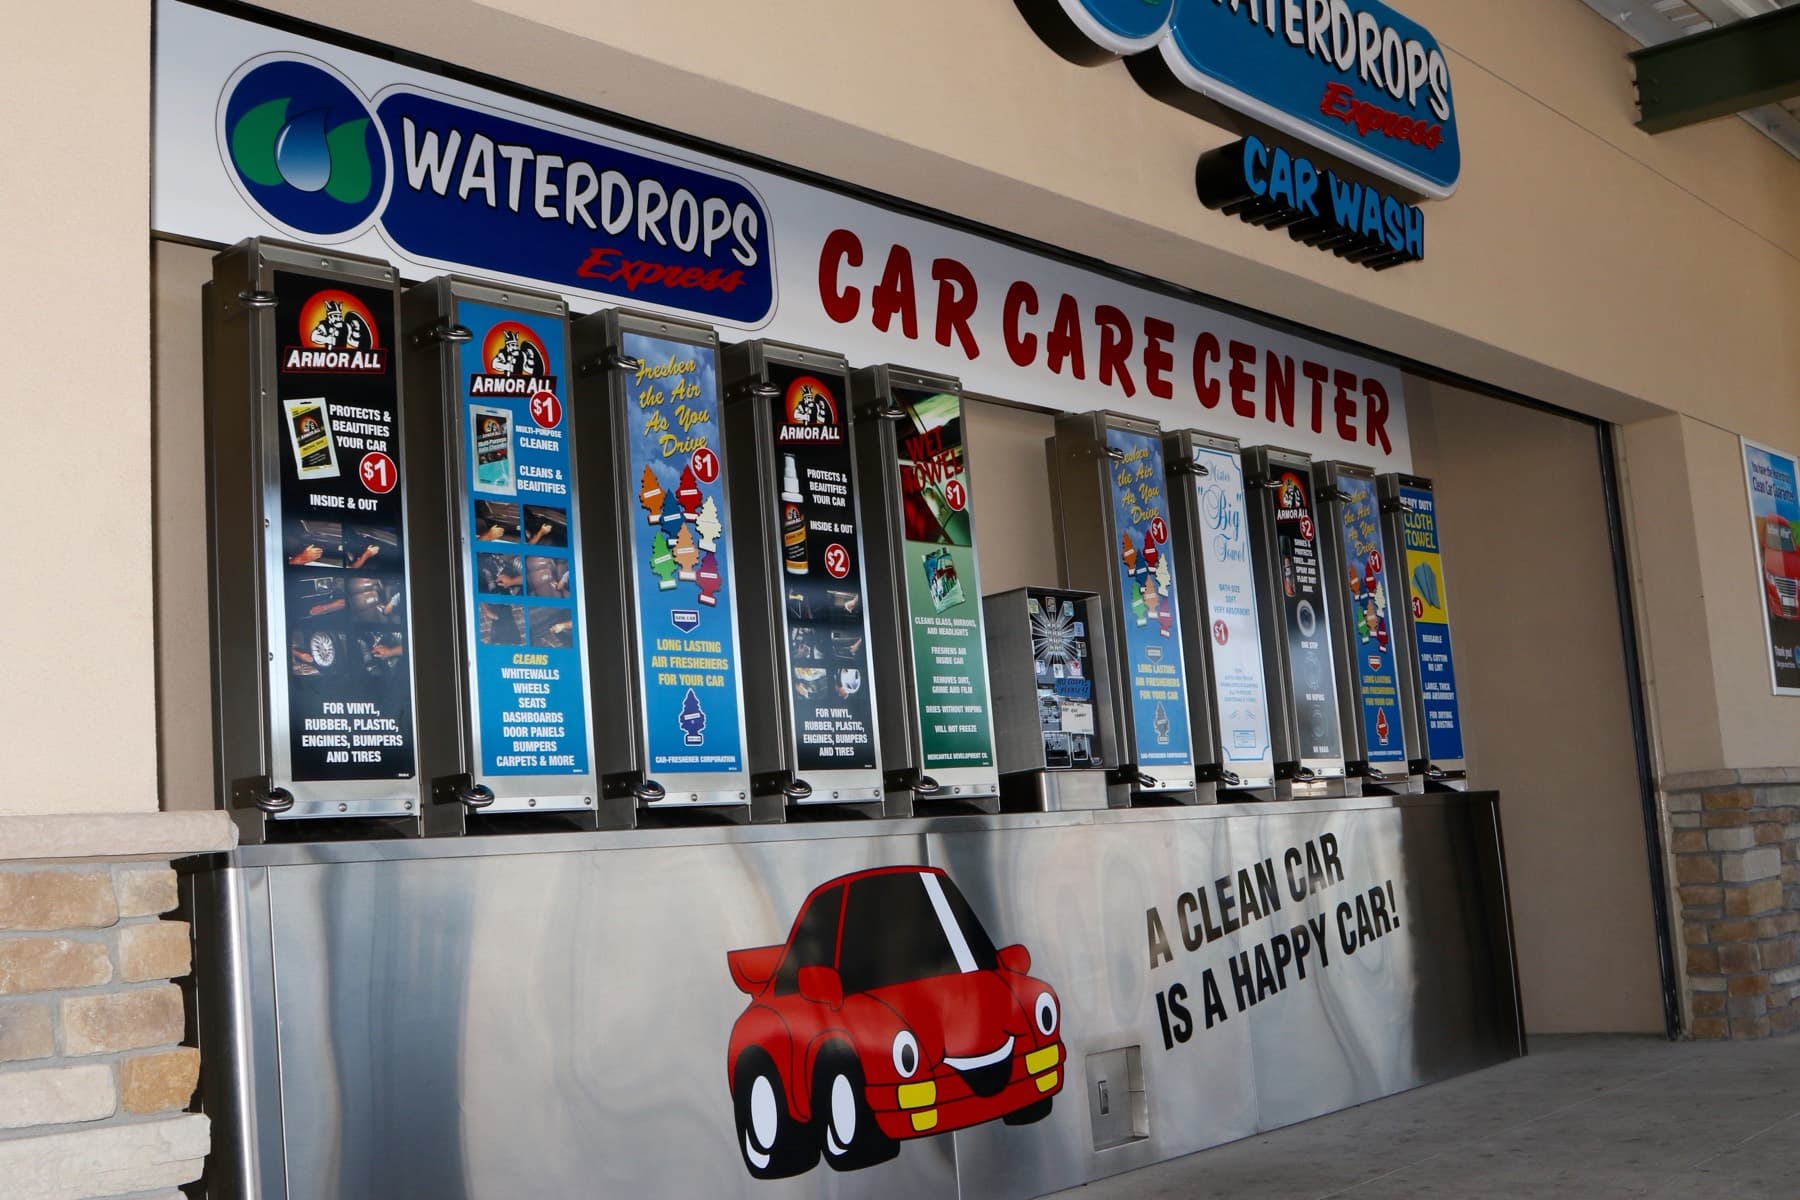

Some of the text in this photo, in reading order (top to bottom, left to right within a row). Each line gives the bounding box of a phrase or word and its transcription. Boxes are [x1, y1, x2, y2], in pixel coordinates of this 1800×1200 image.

[1320, 82, 1444, 150] Express
[402, 115, 758, 266] WATERDROPS
[1243, 135, 1425, 259] CAR WASH
[576, 248, 746, 293] Express
[818, 229, 1392, 456] CAR CARE CENTER
[287, 349, 381, 369] ARMOR ALL
[635, 354, 696, 386] Freshen
[472, 376, 552, 393] ARMOR ALL
[640, 379, 701, 408] the Air
[329, 404, 380, 421] PROTECTS
[383, 411, 391, 422] &
[533, 397, 553, 422] $1
[644, 404, 709, 436] As You
[332, 420, 389, 437] BEAUTIFIES
[780, 425, 840, 440] ARMOR ALL
[336, 435, 364, 449] YOUR
[366, 439, 387, 452] CAR
[520, 436, 559, 451] CLEANER
[658, 434, 707, 457] Drive
[363, 459, 387, 487] $1
[519, 465, 562, 480] CLEANS &
[694, 453, 712, 478] $1
[807, 468, 847, 483] PROTECTS &
[517, 480, 566, 494] BEAUTIFIES
[809, 481, 847, 495] BEAUTIFIES
[947, 484, 961, 505] $1
[310, 494, 378, 511] INSIDE & OUT
[812, 494, 846, 507] YOUR CAR
[1277, 509, 1297, 520] ARMOR
[810, 520, 832, 532] INSIDE
[834, 523, 839, 533] &
[840, 524, 853, 534] OUT
[1152, 521, 1164, 540] $1
[1301, 520, 1312, 537] $2
[1405, 530, 1436, 549] TOWEL
[827, 549, 846, 572] $2
[656, 638, 721, 653] LONG LASTING
[513, 653, 548, 665] CLEANS
[651, 656, 728, 670] AIR FRESHENERS
[501, 667, 560, 680] WHITEWALLS
[658, 673, 724, 687] FOR YOUR CAR
[513, 683, 550, 694] WHEELS
[322, 702, 380, 716] FOR VINYL,
[518, 697, 546, 709] SEATS
[502, 711, 564, 723] DASHBOARDS
[815, 708, 830, 718] FOR
[304, 718, 399, 732] RUBBER, PLASTIC,
[503, 726, 565, 737] DOOR PANELS
[302, 735, 403, 748] ENGINES, BUMPERS
[835, 733, 868, 743] BUMPERS
[513, 741, 557, 752] BUMPERS
[819, 746, 854, 756] AND TIRES
[326, 751, 381, 763] AND TIRES
[496, 755, 575, 767] CARPETS & MORE
[1146, 832, 1344, 970] A CLEAN CAR
[1155, 880, 1400, 1050] IS A HAPPY CAR!
